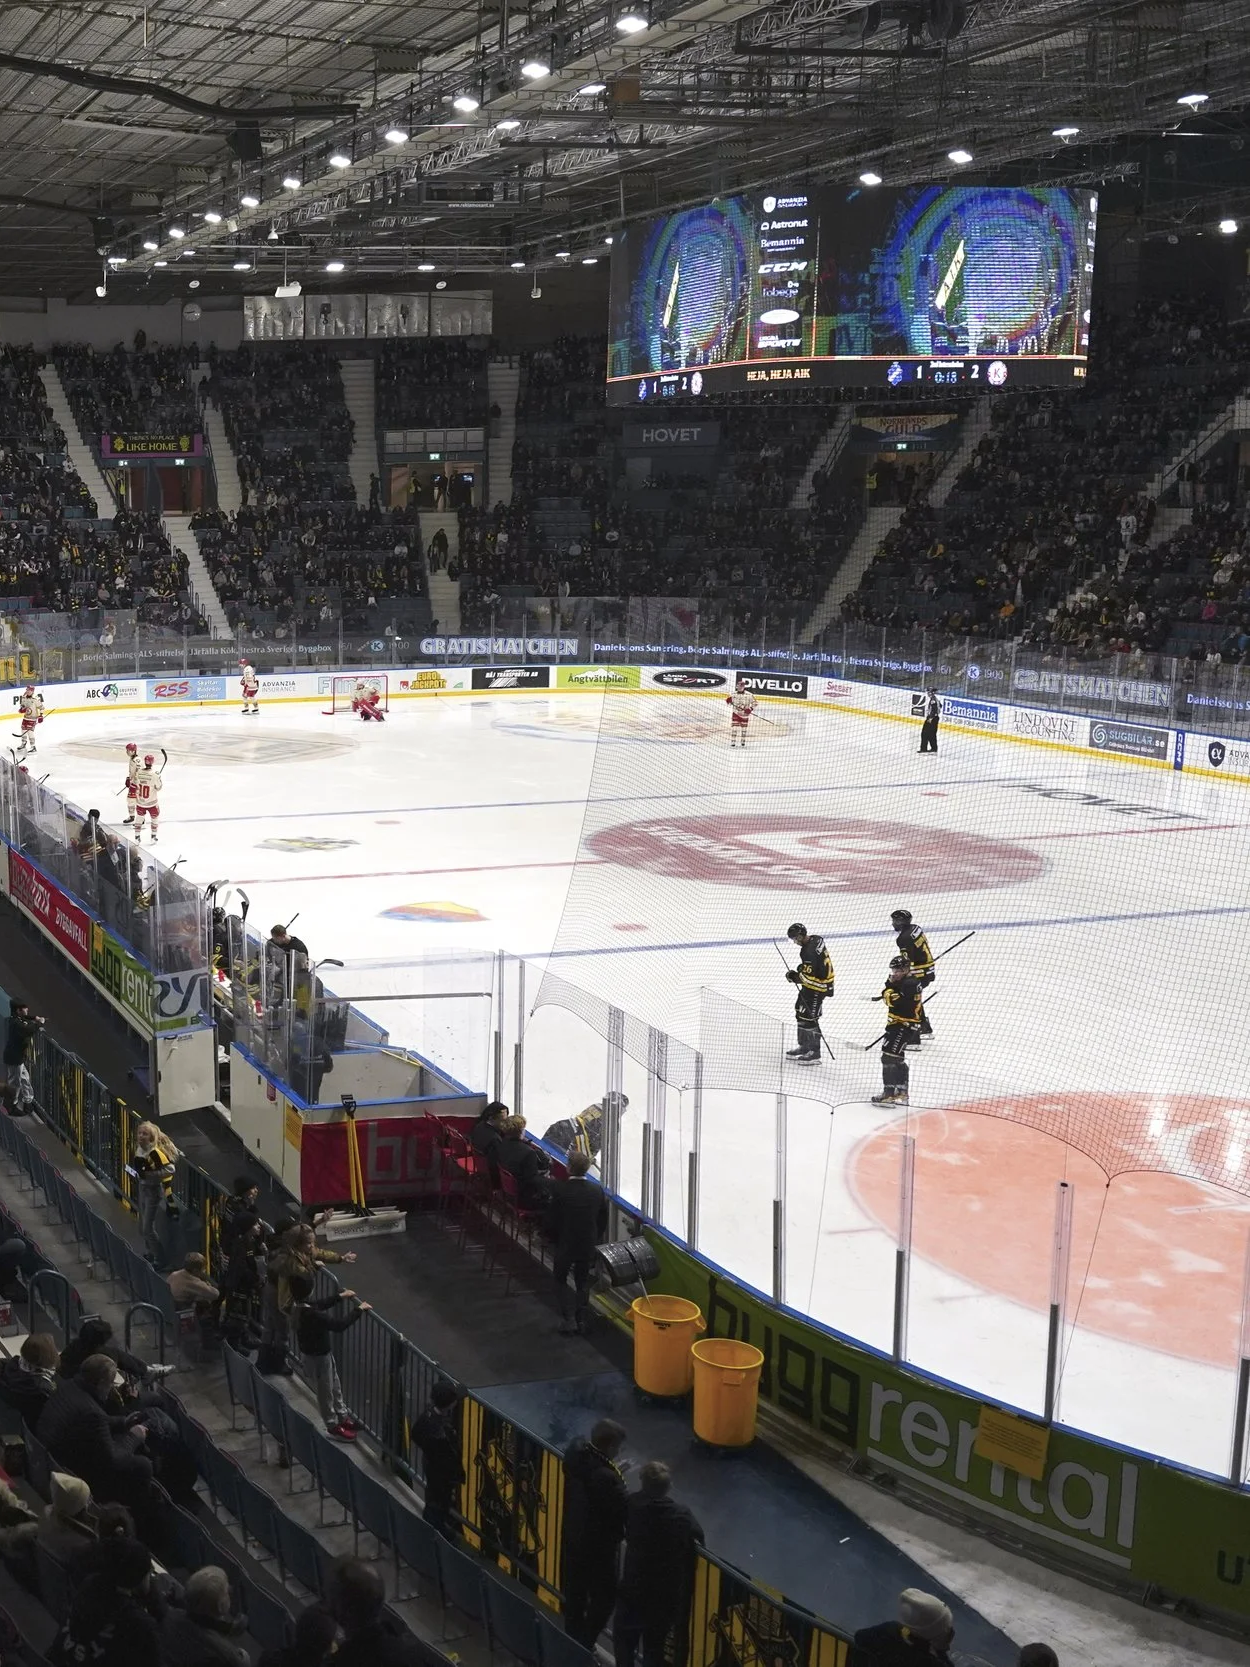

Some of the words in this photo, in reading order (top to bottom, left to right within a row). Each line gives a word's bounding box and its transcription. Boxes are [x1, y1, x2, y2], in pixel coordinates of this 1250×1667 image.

[758, 261, 808, 274] CCM
[747, 371, 769, 381] HEJA,
[770, 370, 792, 379] HEJA
[794, 368, 810, 378] AIK
[916, 365, 923, 379] 1
[971, 364, 980, 379] 2
[642, 428, 701, 442] HOVET
[126, 443, 147, 452] LIKE
[149, 442, 178, 451] HOME
[298, 644, 332, 655] Byggbox
[419, 637, 579, 656] GRATISMATCHEN
[594, 643, 644, 652] Danielsons
[417, 671, 440, 681] EURO
[568, 673, 628, 685] Ångtvättbilen
[663, 677, 719, 685] SPORT
[154, 681, 189, 699] RSS
[410, 679, 447, 690] JACKPOT
[741, 677, 803, 693] DIVELLO
[1014, 668, 1172, 708] GRATISMATCHEN
[86, 689, 101, 699] ABC
[943, 699, 998, 723] Bemannia
[1014, 711, 1077, 733] LINDQVIST
[1014, 722, 1075, 742] ACCOUNTING
[1109, 730, 1165, 748] SUGBILAR.se
[138, 783, 150, 799] 10
[55, 907, 88, 952] BYGGAVFALL
